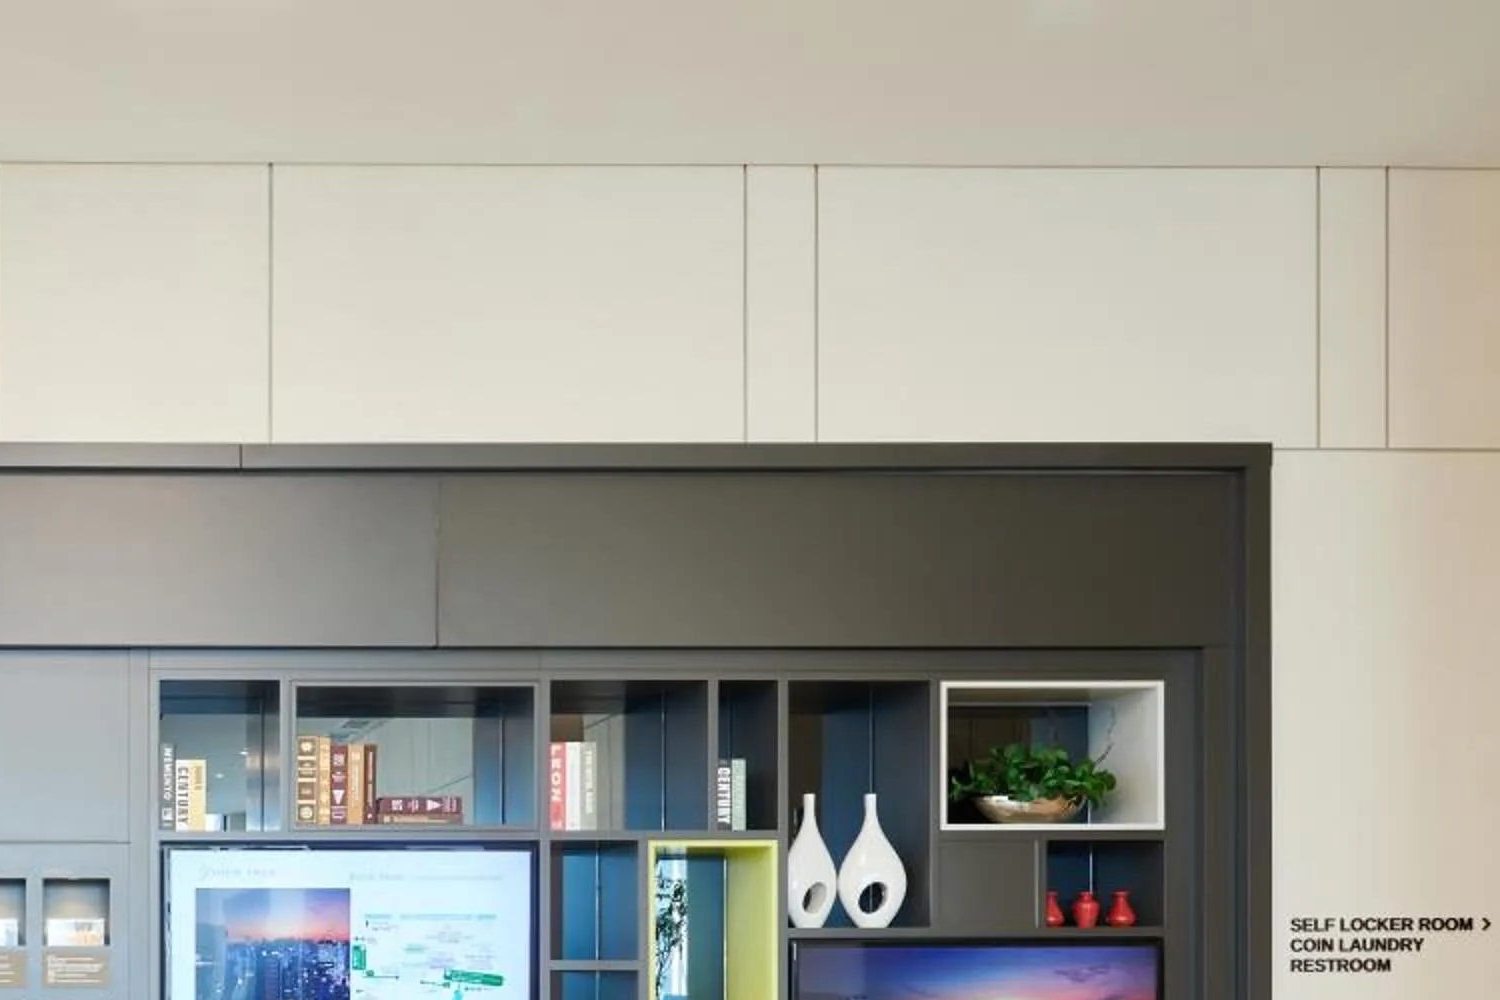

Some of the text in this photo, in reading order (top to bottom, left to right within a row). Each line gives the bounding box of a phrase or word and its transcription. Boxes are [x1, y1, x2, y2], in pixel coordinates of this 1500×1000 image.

[177, 767, 189, 825] CENTURY
[1290, 917, 1474, 932] SELF LOCKER ROOM
[1290, 938, 1425, 953] COIN LAUNDRY
[1290, 958, 1392, 973] RESTROOM
